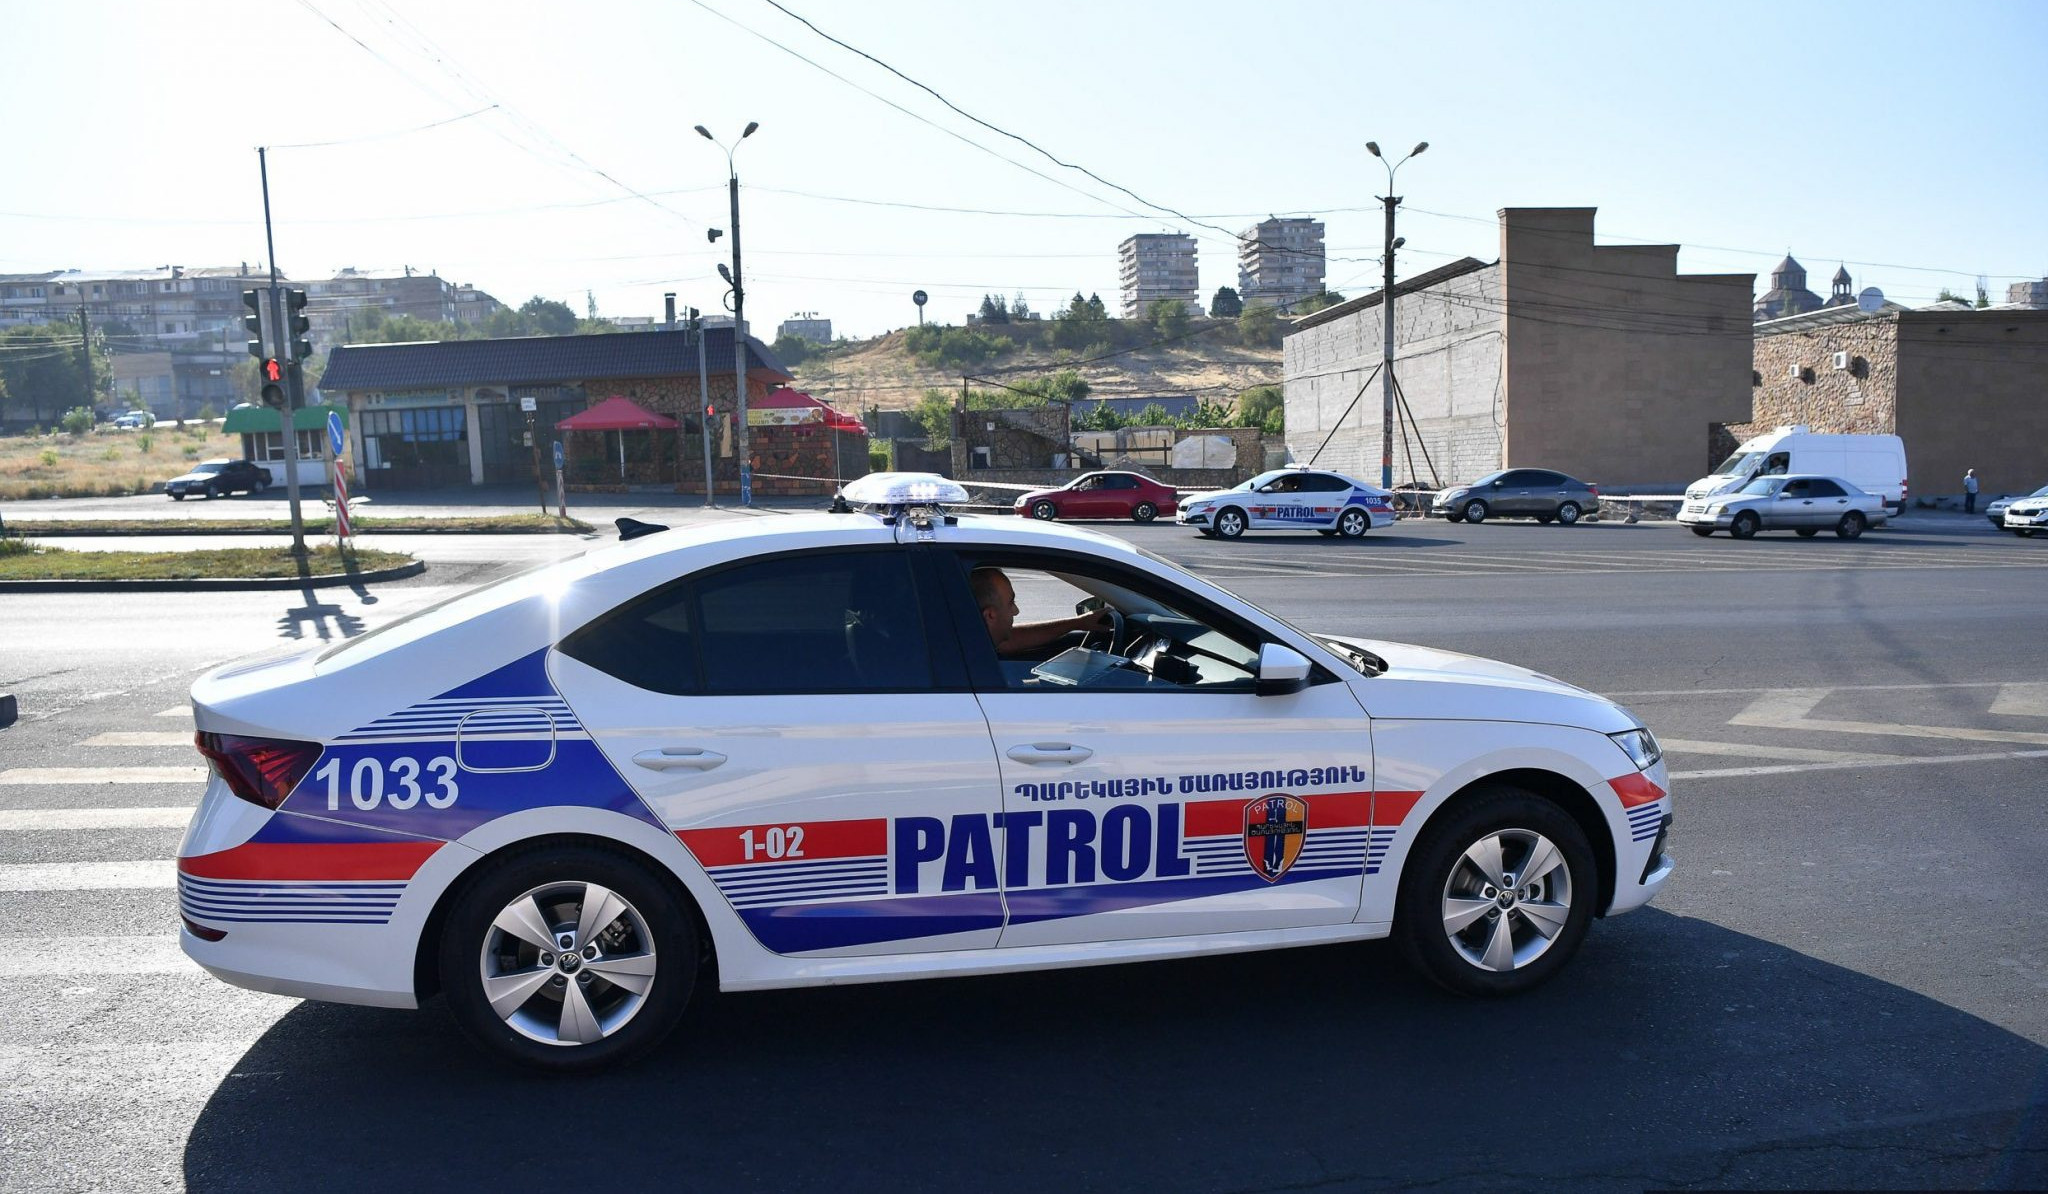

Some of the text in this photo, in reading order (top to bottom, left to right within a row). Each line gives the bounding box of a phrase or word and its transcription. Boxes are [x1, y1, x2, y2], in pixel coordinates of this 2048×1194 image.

[1277, 507, 1315, 518] PATROL
[316, 756, 459, 811] 1033
[1014, 765, 1366, 802] ՊԱՐԵԿԱՅԻՆ ԾԱՌԱՅՈՒԹՅՈՒՆ
[1254, 799, 1298, 814] PATROL
[739, 826, 805, 861] 1-02
[894, 803, 1191, 895] PATROL
